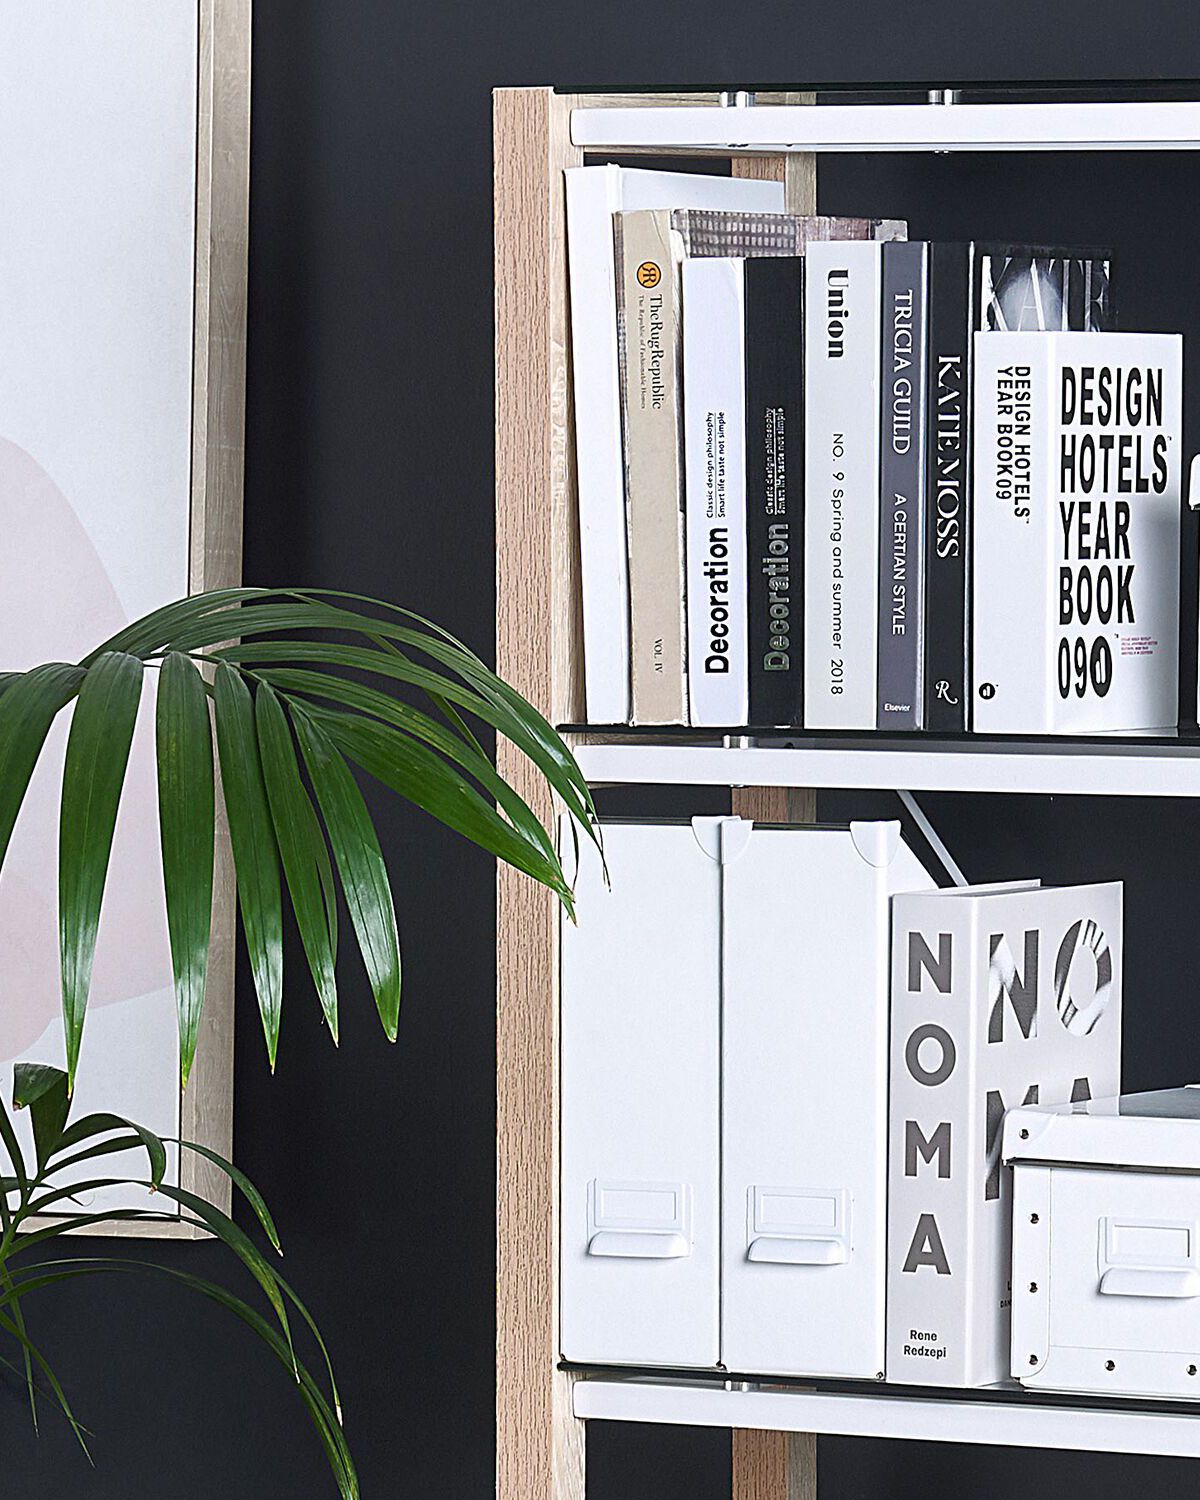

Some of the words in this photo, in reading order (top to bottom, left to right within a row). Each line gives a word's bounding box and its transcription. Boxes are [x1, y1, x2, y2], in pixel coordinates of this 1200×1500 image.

[827, 269, 849, 359] Union
[893, 289, 913, 372] TRICIA
[893, 378, 912, 454] GUILD
[938, 355, 961, 452] KATE
[997, 366, 1013, 415] YEAR
[1014, 366, 1031, 435] DESIGN
[1062, 366, 1162, 426] DESIGN
[706, 412, 715, 458] philosophy
[717, 412, 726, 438] simple
[832, 433, 844, 462] NO.
[706, 460, 715, 488] design
[833, 471, 845, 481] 9
[1060, 434, 1168, 494] HOTELS
[706, 490, 714, 518] Classic
[718, 493, 726, 518] Smart
[830, 488, 844, 542] Spring
[894, 493, 907, 505] A
[936, 456, 960, 558] MOSS
[893, 510, 907, 580] CERTIAN
[1059, 501, 1131, 560] YEAR
[832, 547, 844, 578] and
[703, 527, 729, 673] Decoration
[762, 523, 790, 671] Decoration
[832, 583, 842, 650] summer
[892, 585, 906, 635] STYLE
[1059, 565, 1135, 625] BOOK
[830, 659, 843, 695] 2018
[987, 918, 1112, 1044] NO
[902, 931, 956, 1275] NOMA
[903, 1345, 947, 1360] Redzepi
[910, 1329, 938, 1341] Rene
